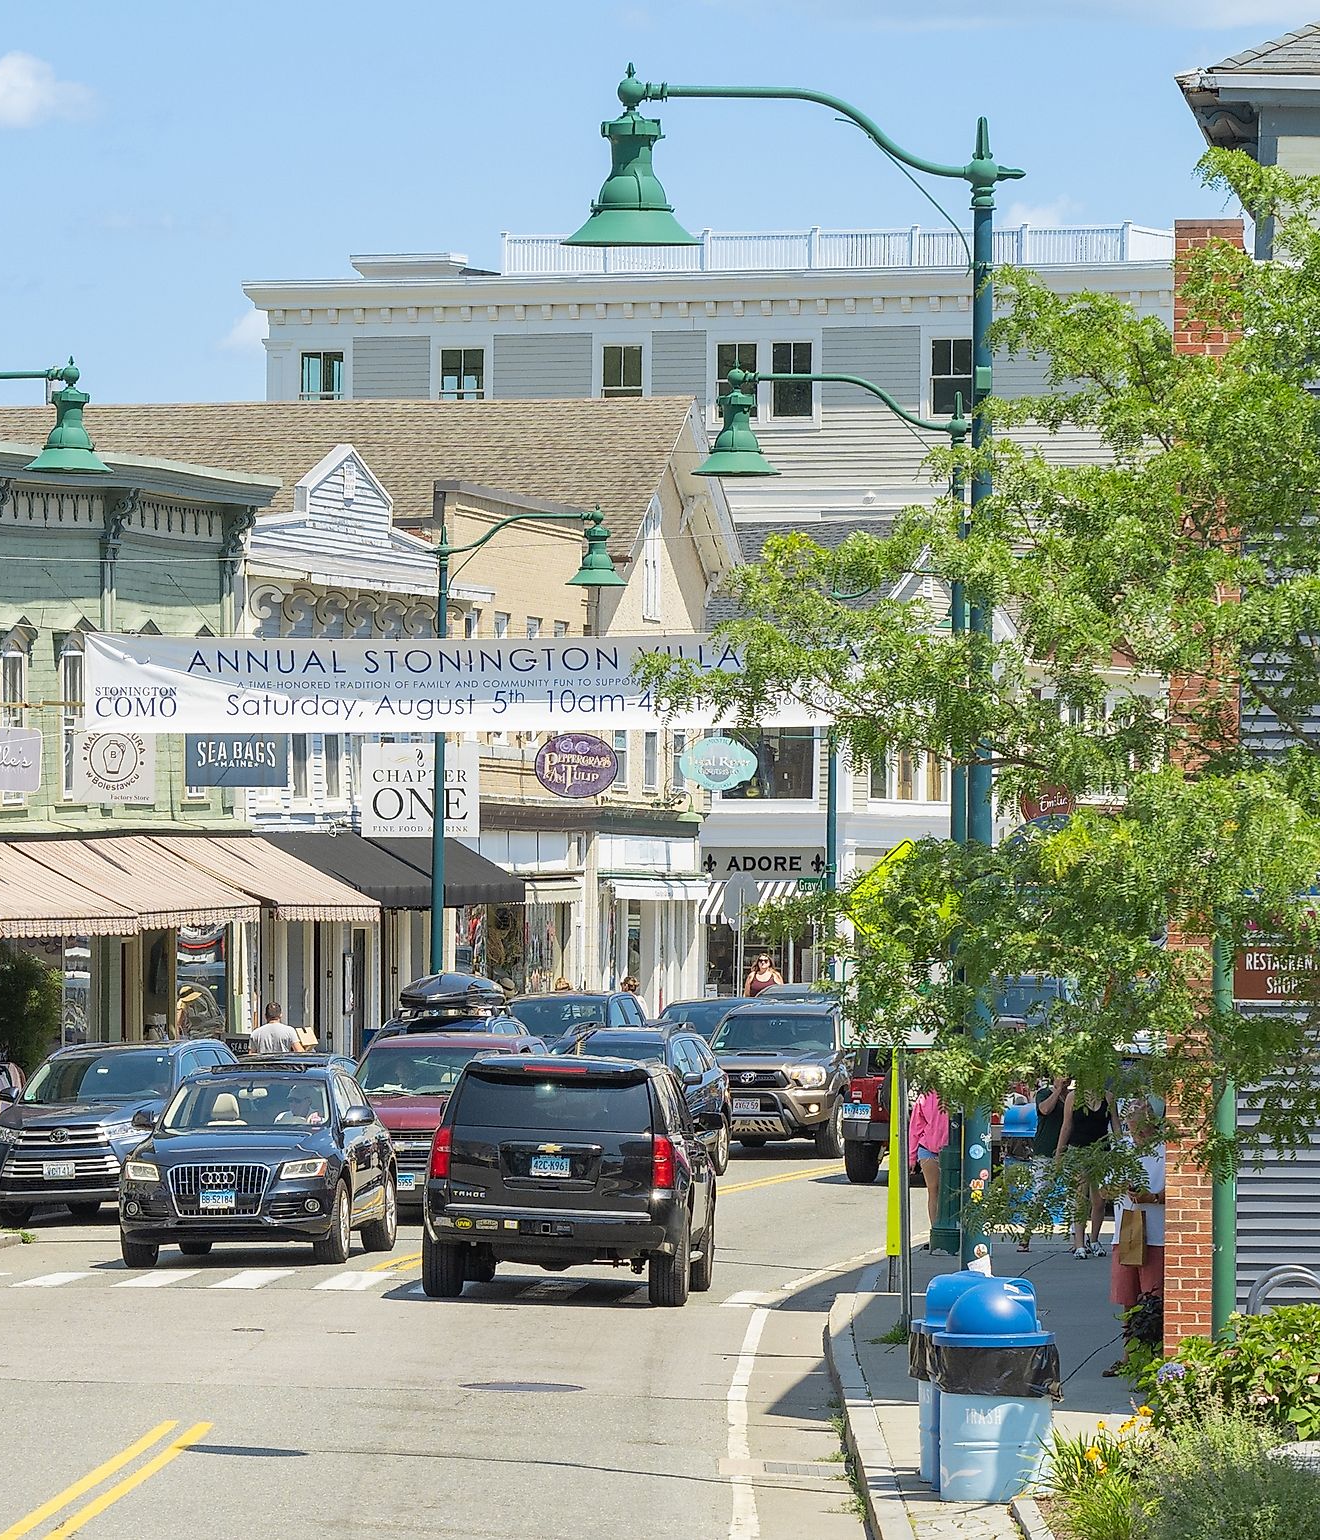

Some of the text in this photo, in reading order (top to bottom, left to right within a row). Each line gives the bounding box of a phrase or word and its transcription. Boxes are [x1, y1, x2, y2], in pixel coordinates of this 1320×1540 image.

[187, 649, 346, 674] ANNUAL
[364, 647, 618, 674] STONINGTON
[94, 686, 178, 697] STONINGTON
[236, 681, 245, 689] A
[249, 681, 331, 689] TIME-HONORED
[335, 680, 391, 689] TRADITION
[394, 680, 409, 689] OF
[413, 680, 451, 689] FAMILY
[454, 680, 479, 688] AND
[482, 679, 550, 688] COMMUNITY
[553, 678, 574, 687] FUN
[578, 678, 592, 686] TO
[95, 696, 178, 718] COMO
[226, 694, 363, 721] Saturday,
[374, 693, 476, 721] August
[492, 689, 525, 714] 5th
[197, 741, 276, 768] SEA BAGS
[220, 760, 253, 768] MAINE
[110, 794, 133, 802] Factory
[372, 787, 468, 820] ONE
[726, 855, 802, 872] ADORE
[452, 1190, 486, 1198] TAHOE
[965, 1408, 1001, 1425] TRASH
